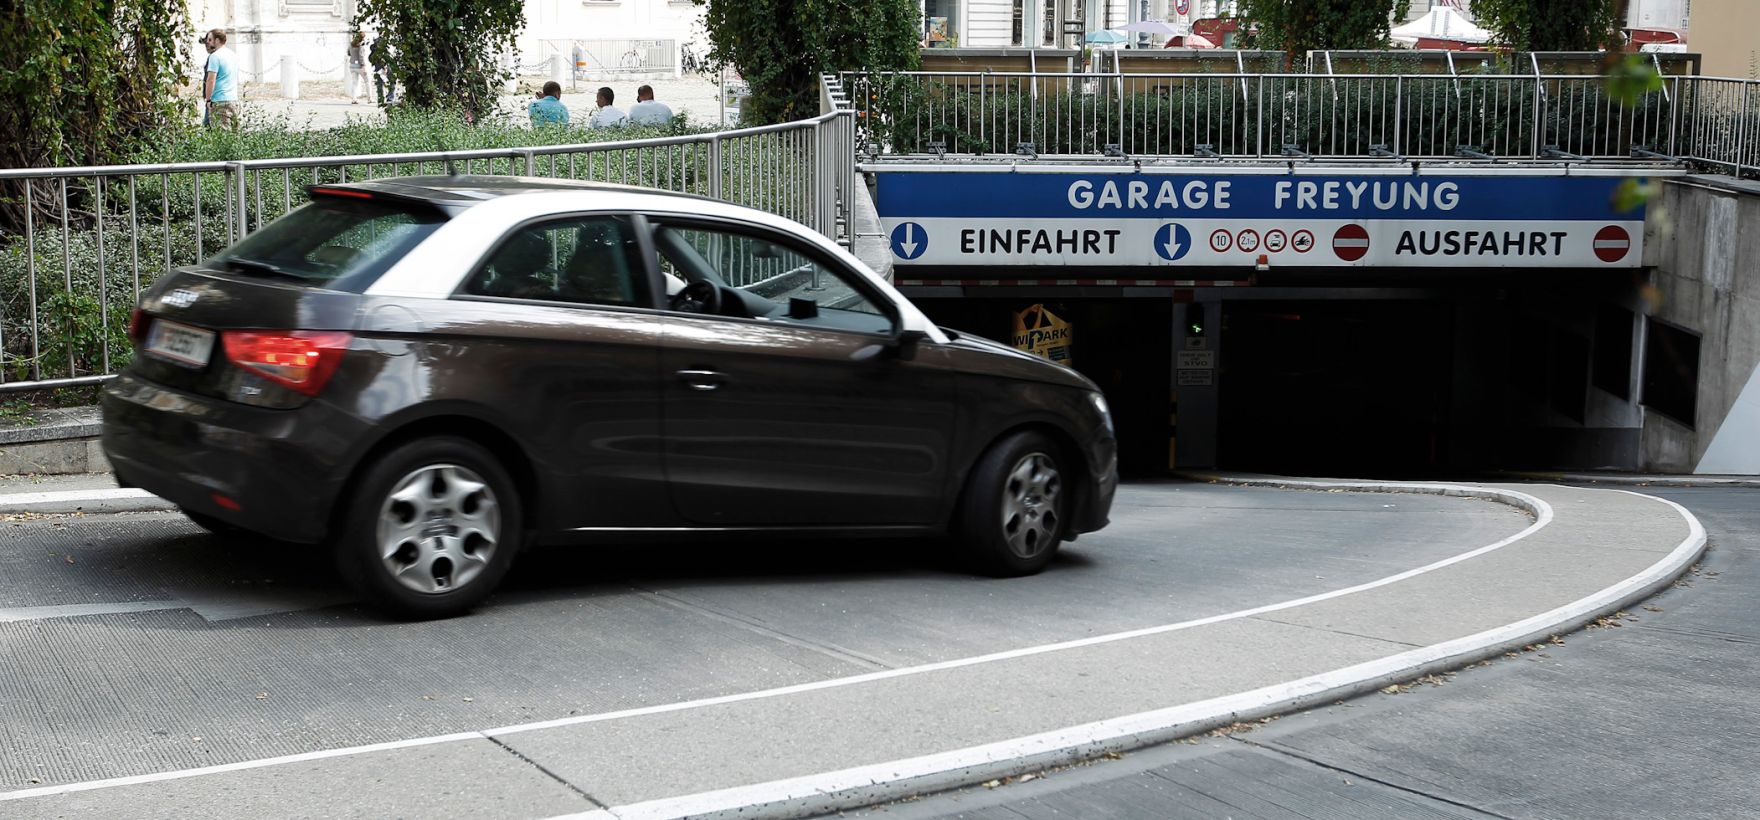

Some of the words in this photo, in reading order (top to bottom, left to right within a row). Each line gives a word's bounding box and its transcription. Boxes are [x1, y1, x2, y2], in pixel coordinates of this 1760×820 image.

[1067, 180, 1232, 210] GARAGE
[1274, 181, 1460, 211] FREYUNG
[960, 228, 1121, 254] EINFAHRT
[1216, 235, 1227, 247] 10
[1395, 230, 1568, 256] AUSFAHRT
[1013, 328, 1069, 350] WIPARK
